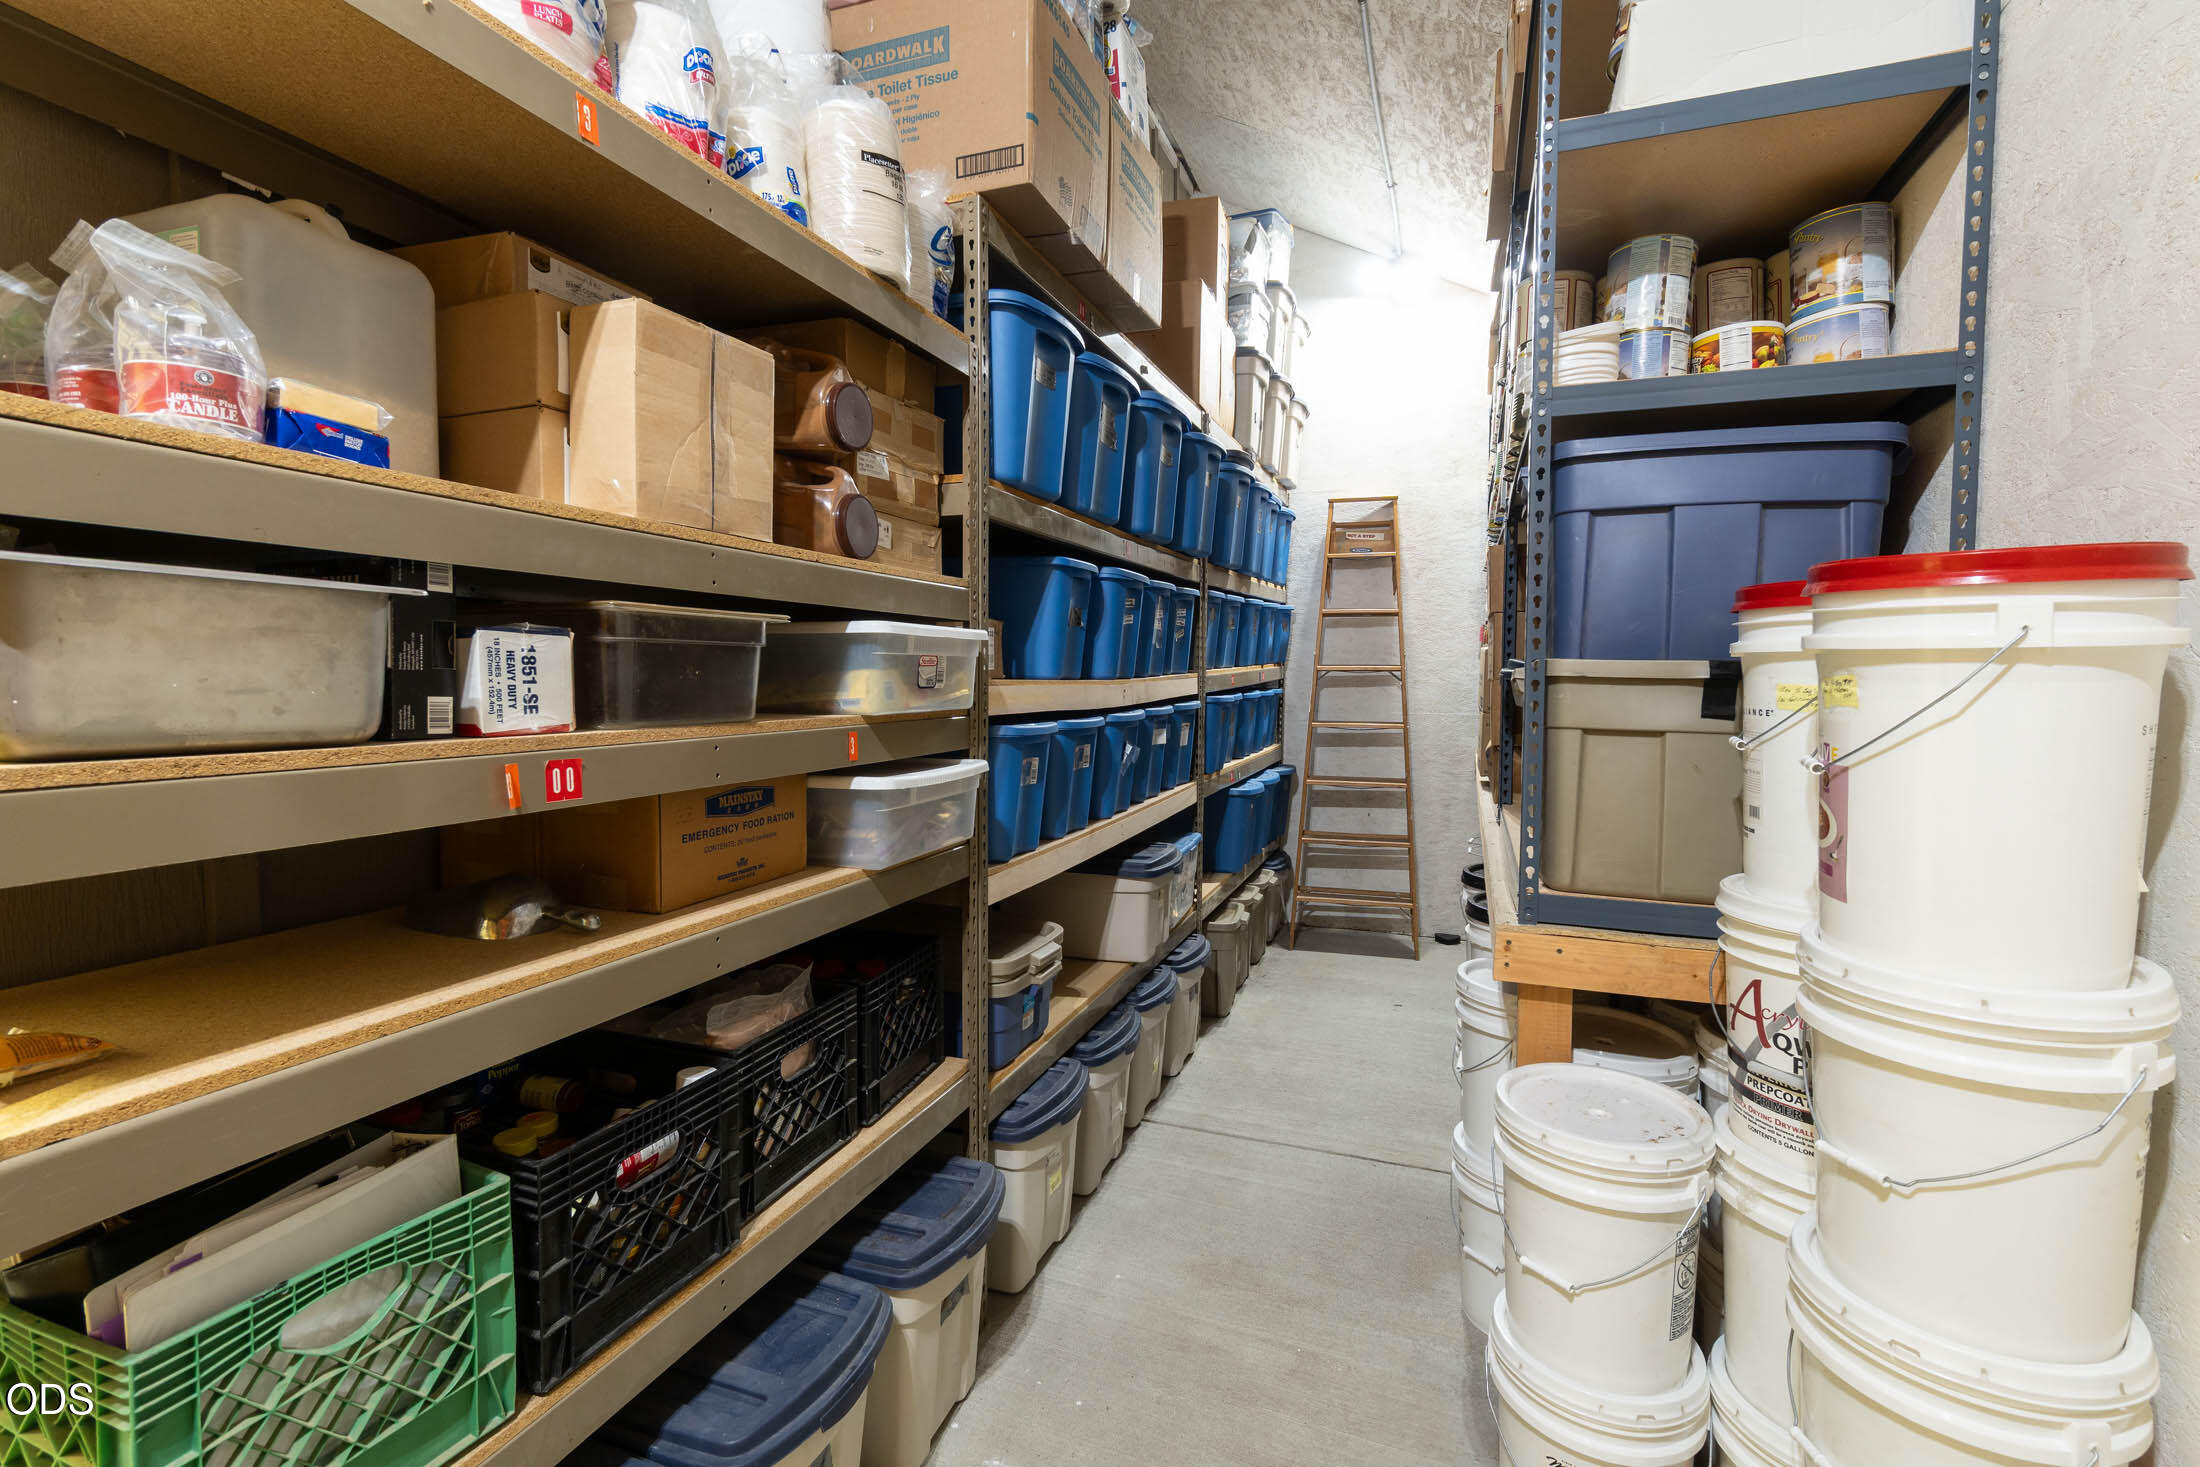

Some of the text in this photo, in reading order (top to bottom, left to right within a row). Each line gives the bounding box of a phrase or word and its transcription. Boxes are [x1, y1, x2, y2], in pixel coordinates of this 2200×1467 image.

[533, 4, 564, 19] LUNCH
[534, 13, 564, 28] PLATES
[849, 34, 945, 71] OARDWALK
[877, 79, 913, 97] Toilet
[915, 69, 959, 89] Tissue
[583, 104, 592, 133] 3
[167, 400, 239, 422] CANDLE
[169, 391, 217, 407] 100-Hour
[218, 399, 238, 410] Plus
[493, 647, 502, 678] INCHES
[506, 650, 518, 710] HEAVY DUTY
[495, 688, 503, 702] 500
[496, 703, 504, 724] FEET
[718, 789, 765, 808] MAINSTAY
[681, 823, 740, 844] EMERGENCY
[743, 817, 765, 830] FOOD
[767, 811, 795, 825] RATION
[1728, 978, 1811, 1049] Acry
[1747, 1075, 1811, 1109] PREPCOAT
[1754, 1091, 1802, 1120] PRIMER
[1748, 1124, 1777, 1144] CONTENTS
[1783, 1143, 1815, 1157] GALLON
[1774, 1118, 1815, 1139] DRYWALL
